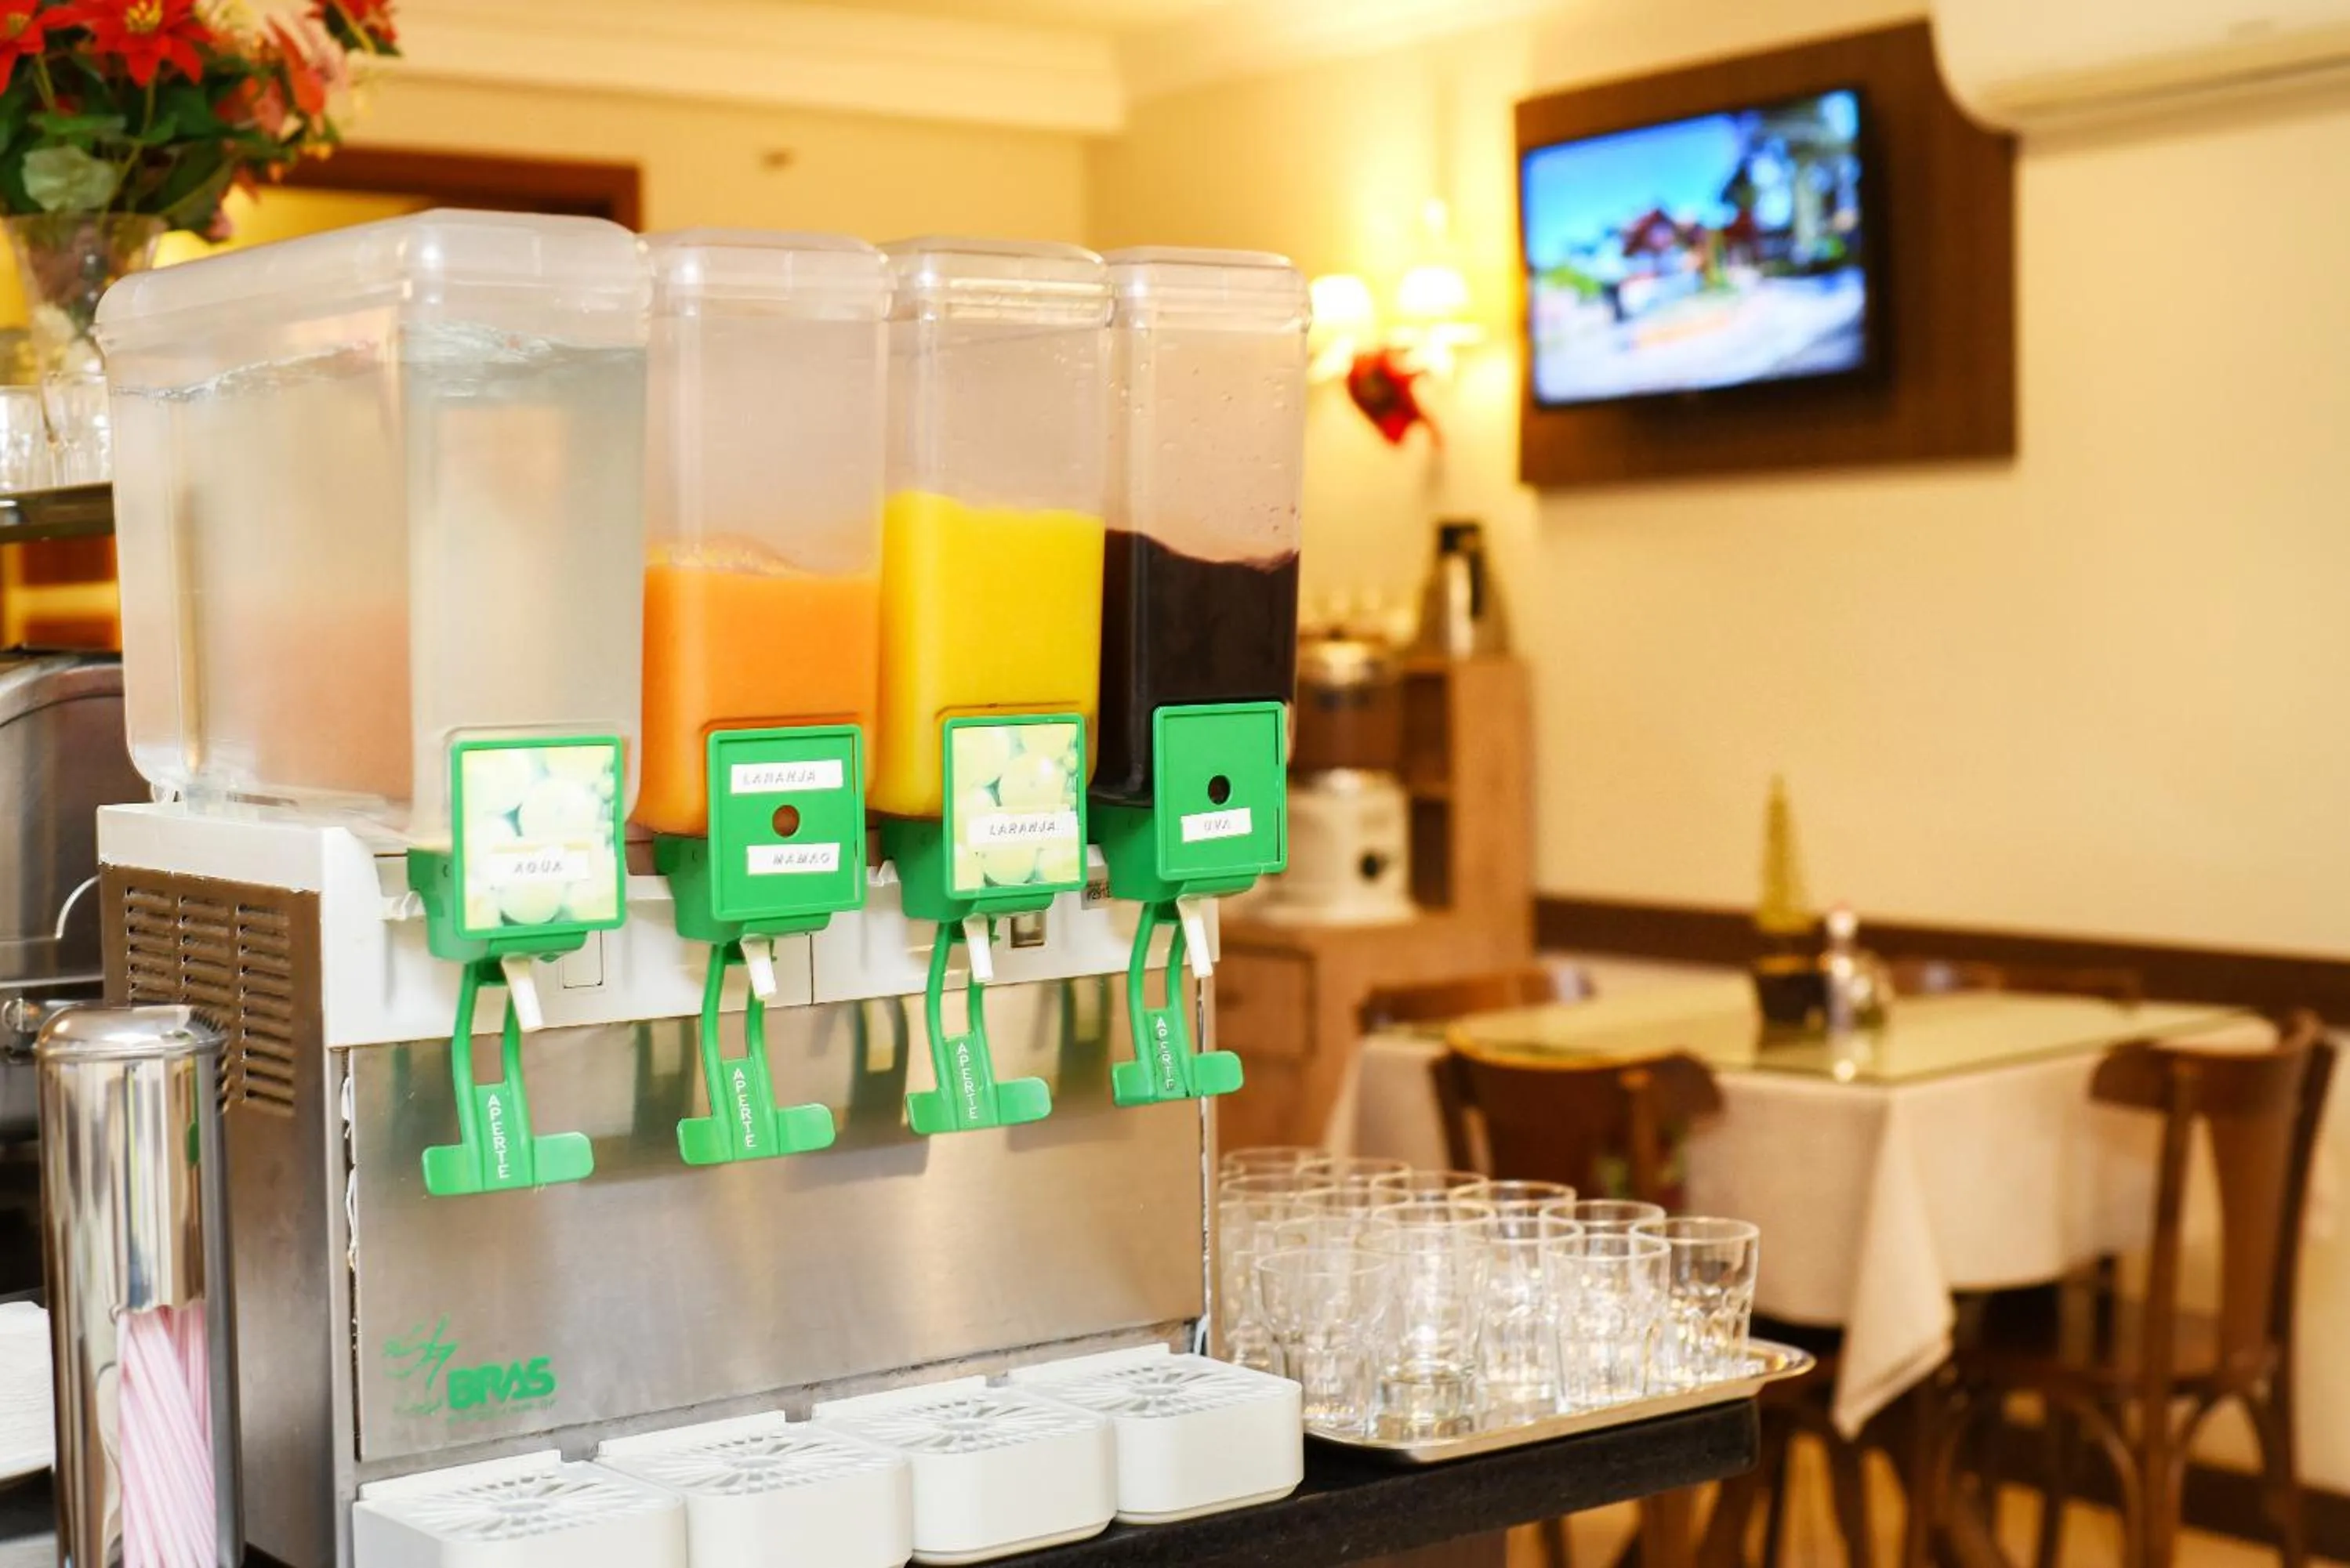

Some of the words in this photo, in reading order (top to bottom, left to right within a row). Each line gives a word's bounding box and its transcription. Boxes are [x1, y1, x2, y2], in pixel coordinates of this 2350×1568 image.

[989, 820, 1056, 835] LARANJA
[733, 1067, 757, 1148] APERTE
[957, 1042, 978, 1119] APERTE
[488, 1093, 511, 1179] APERTE
[448, 1356, 556, 1410] BRAS
